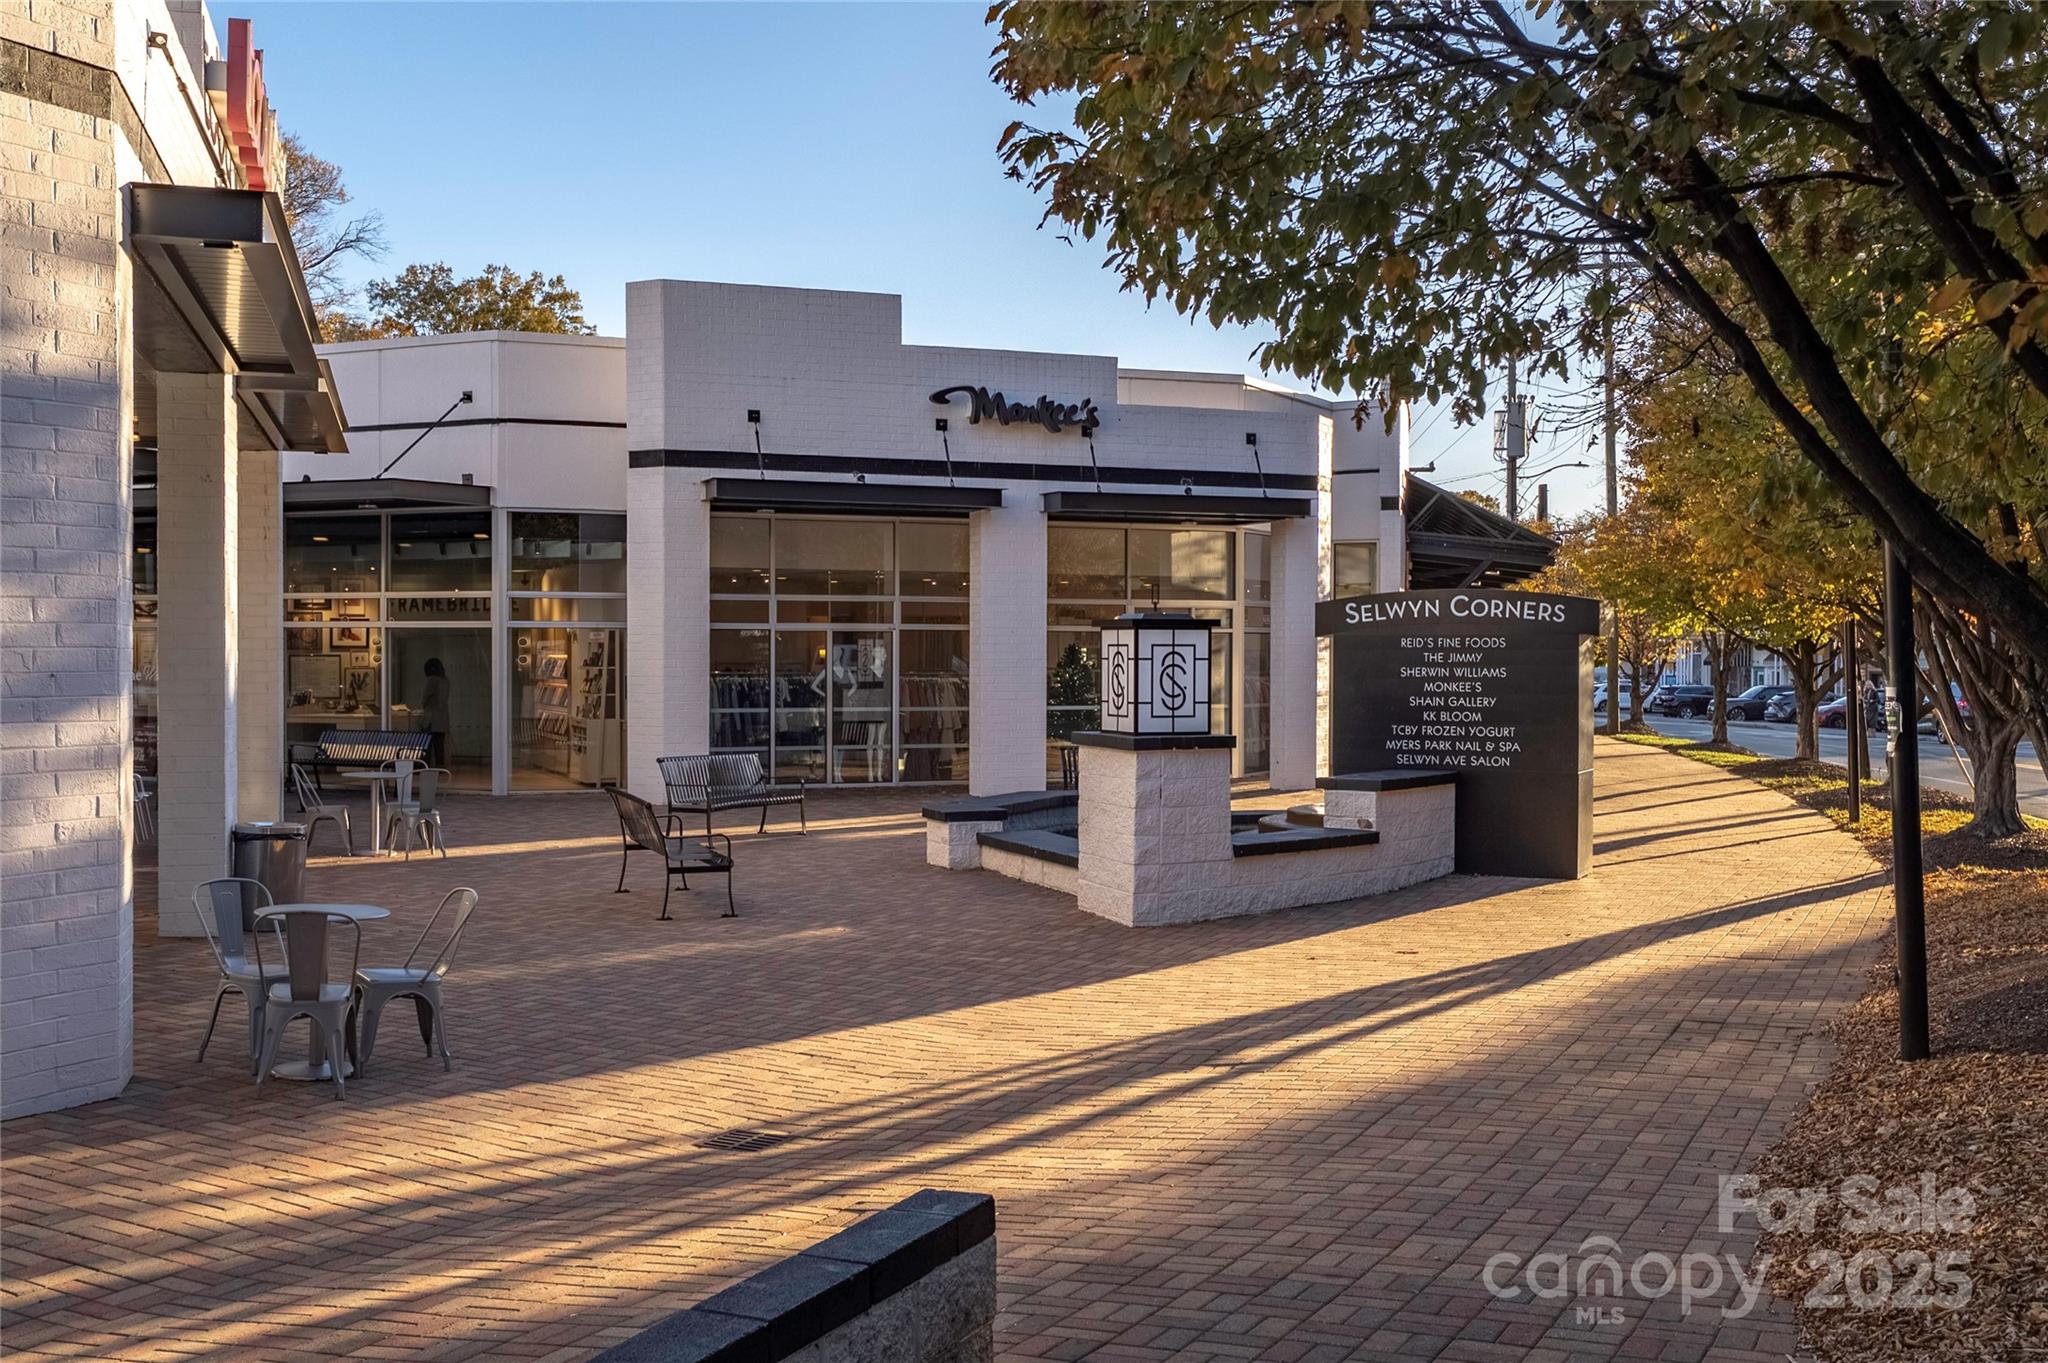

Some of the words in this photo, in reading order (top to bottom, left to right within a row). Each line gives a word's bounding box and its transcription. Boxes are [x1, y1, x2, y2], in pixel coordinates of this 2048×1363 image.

[929, 386, 1100, 433] Monkee's
[1400, 637, 1434, 648] REID'S
[1438, 637, 1461, 648] FINE
[1465, 637, 1506, 648] FOODS
[1423, 652, 1444, 663] THE
[1447, 652, 1483, 663] JIMMY
[1400, 667, 1449, 678] SHERWIN
[1453, 667, 1507, 678] WILLIAMS
[1423, 682, 1482, 693] MONKEE'S
[1409, 696, 1444, 707] SHAIN
[1448, 696, 1497, 708] GALLERY
[1423, 711, 1437, 722] KK
[1440, 711, 1482, 722] BLOOM
[1391, 725, 1418, 736] TCBY
[1421, 725, 1465, 736] FROZEN
[1469, 726, 1516, 737] YOGURT
[1385, 740, 1421, 751] MYERS
[1424, 740, 1452, 751] PARK
[1455, 741, 1481, 752] NAIL
[1485, 741, 1495, 752] &
[1499, 742, 1521, 753] SPA
[1396, 754, 1440, 765] SELWYN
[1443, 755, 1467, 766] AVE
[1470, 756, 1510, 767] SALON
